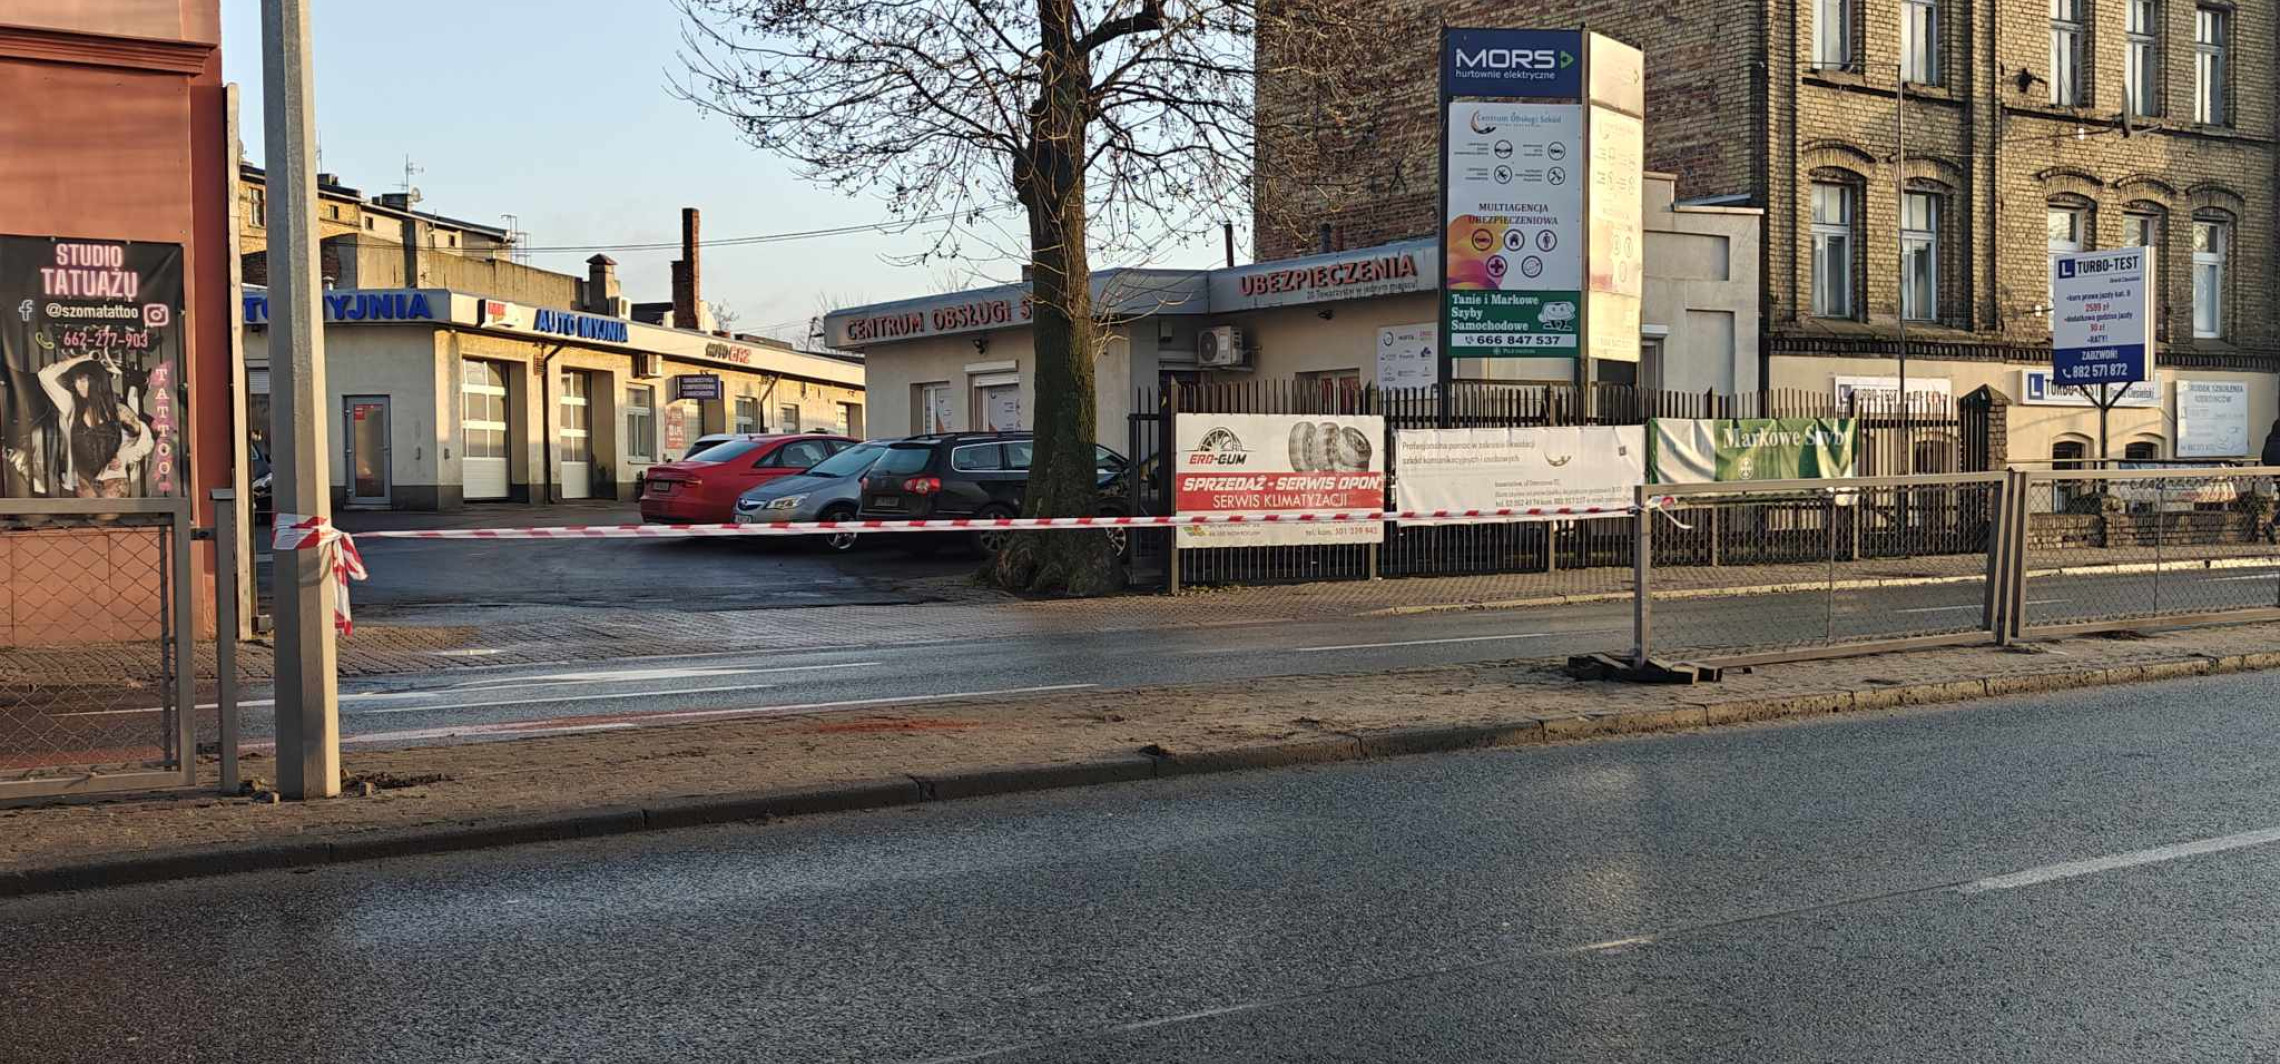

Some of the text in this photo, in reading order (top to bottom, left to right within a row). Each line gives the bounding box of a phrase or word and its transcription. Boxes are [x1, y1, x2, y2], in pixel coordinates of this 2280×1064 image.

[1456, 48, 1555, 69] MORS
[1455, 69, 1556, 80] hurtownie elektryczne
[1478, 203, 1549, 212] MULTIAGENCJA
[1469, 215, 1559, 225] UBEZPIECZENIOWA
[57, 243, 124, 267] STUDIO
[2077, 255, 2139, 274] TURBO-TEST
[41, 268, 139, 298] TATUAŻU
[1239, 254, 1418, 296] UBEZPIECZENIA
[1451, 293, 1540, 305] Tanie i Markowe
[2100, 291, 2114, 300] jazdy
[45, 302, 139, 318] @szomatattoo
[323, 293, 432, 320] YJNIA
[1451, 307, 1483, 320] Szyby
[847, 312, 925, 341] CENTRUM
[932, 299, 1012, 331] OBSŁUGI
[2118, 312, 2133, 320] jazdy
[534, 308, 577, 336] AUTO
[577, 315, 629, 343] MYJNIA
[1451, 320, 1529, 331] Samochodowe
[64, 330, 149, 348] 662-277-903
[1477, 336, 1561, 345] 666 847 537
[2082, 348, 2118, 360] ZADZWOŃ!
[2072, 363, 2128, 379] 882 571 872
[155, 368, 170, 474] TATTOO
[1723, 427, 1800, 448] Markowe
[1188, 454, 1248, 465] ERO-GUM
[1182, 475, 1267, 492] SPRZEDAŻ
[1275, 476, 1335, 491] SERWIS
[1337, 476, 1380, 490] OPON
[1212, 494, 1348, 509] SERWIS KLIMATYZACJI
